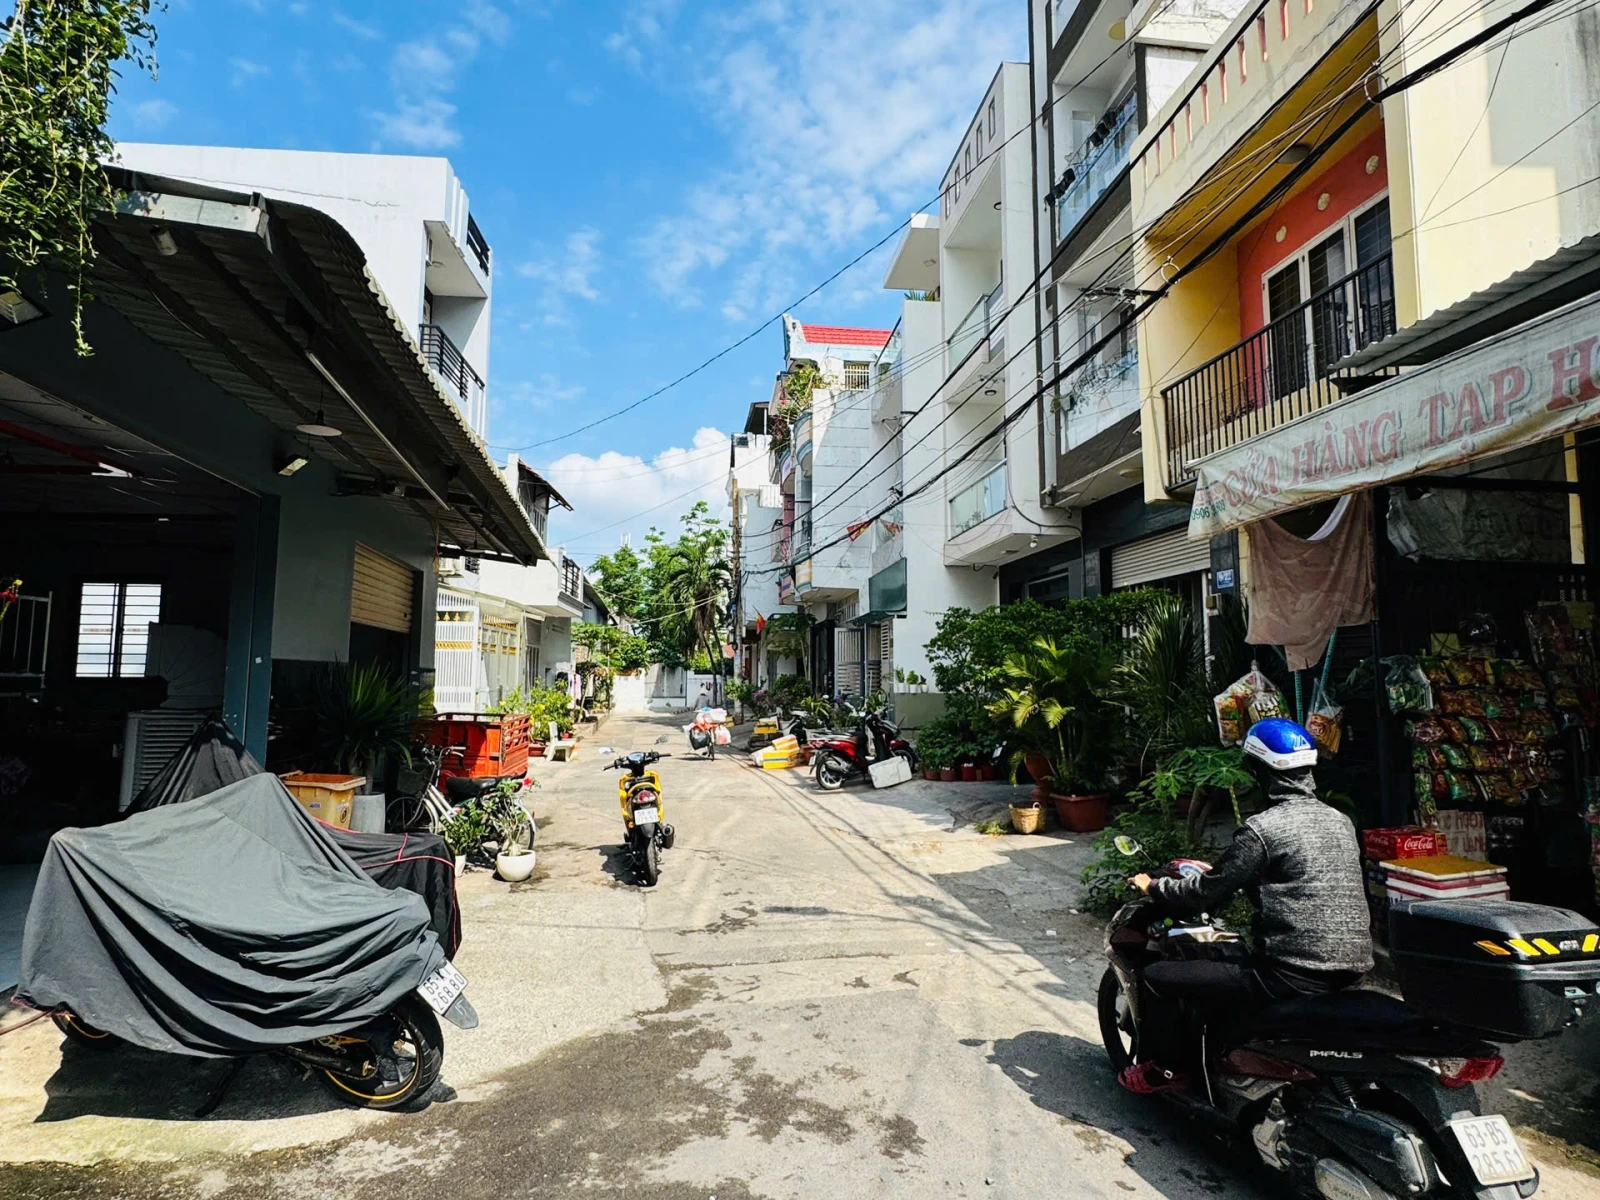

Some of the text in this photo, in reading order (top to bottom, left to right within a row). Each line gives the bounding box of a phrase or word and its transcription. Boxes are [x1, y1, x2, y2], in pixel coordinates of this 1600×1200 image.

[1288, 411, 1400, 486] HÀNG
[1418, 366, 1526, 450] TẠP
[1546, 335, 1600, 412] H
